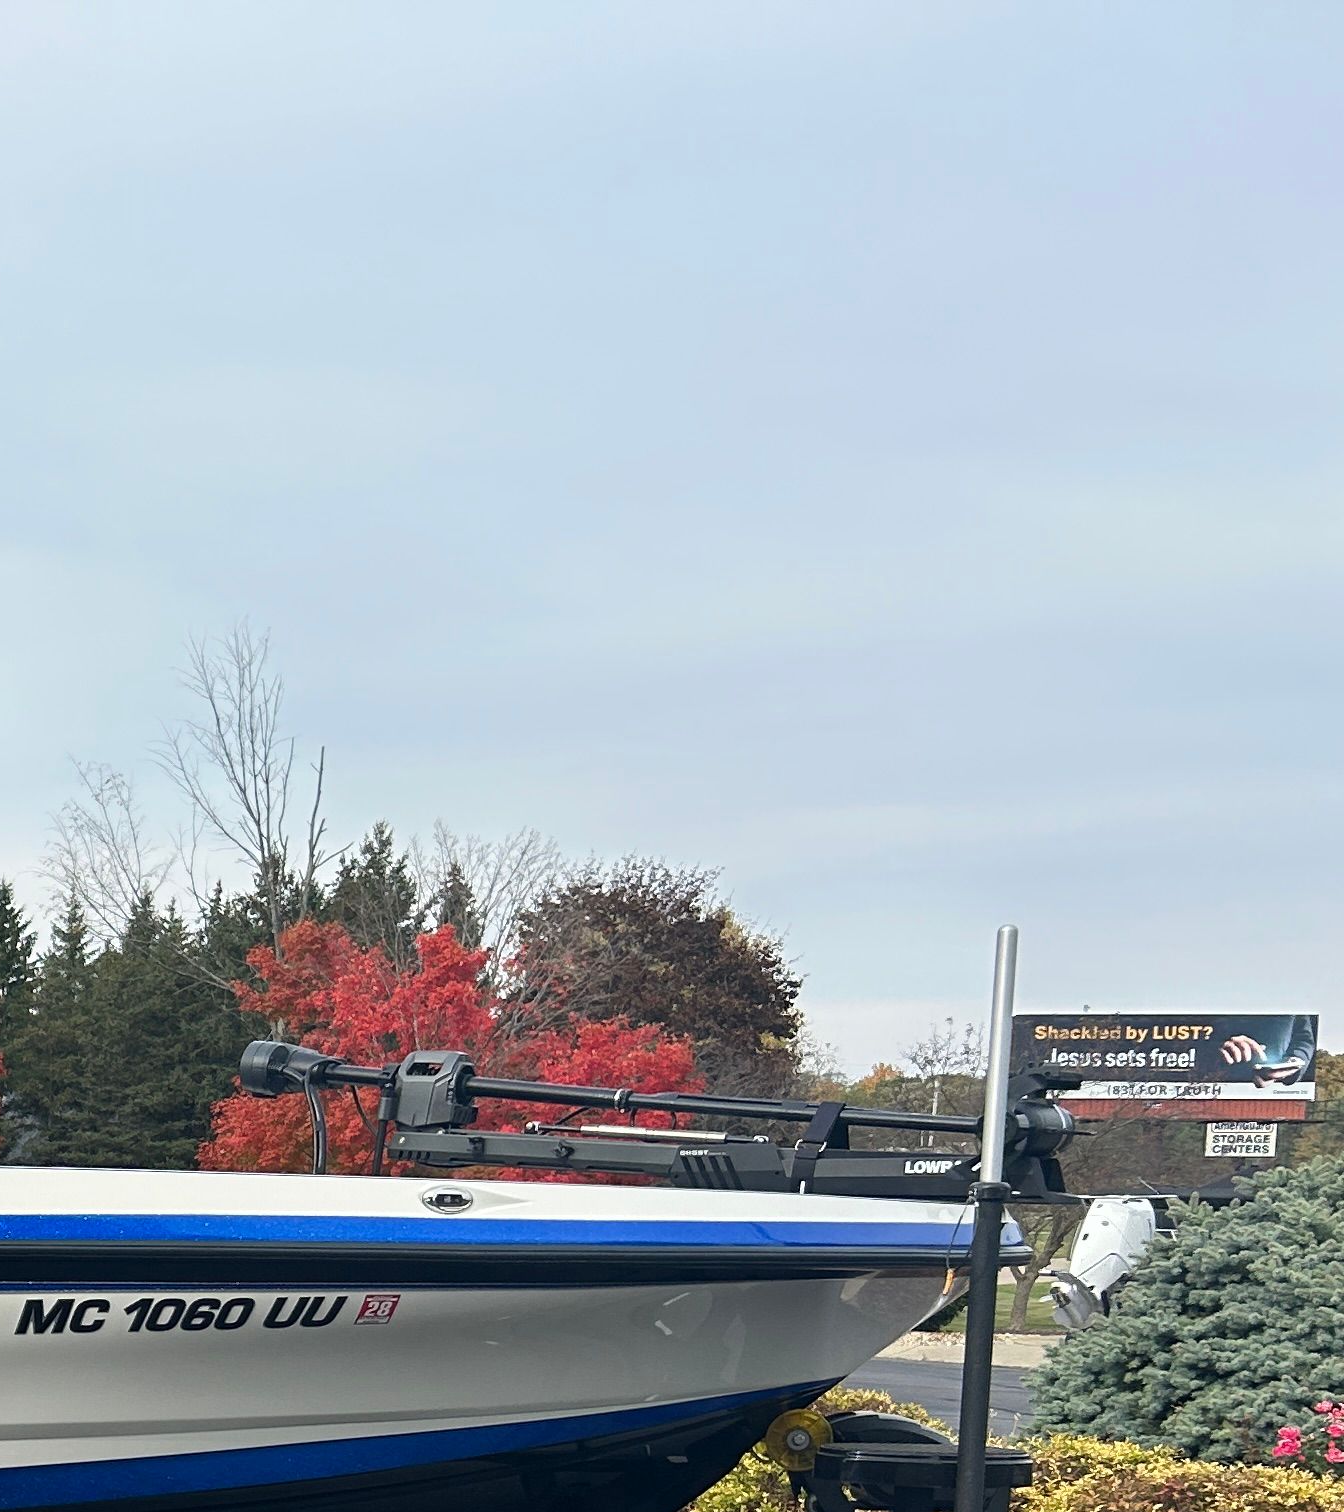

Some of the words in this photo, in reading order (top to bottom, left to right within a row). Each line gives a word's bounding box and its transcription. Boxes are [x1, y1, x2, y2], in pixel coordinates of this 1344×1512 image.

[1034, 1025, 1121, 1041] Shackled
[1126, 1025, 1149, 1043] by
[1152, 1025, 1214, 1040] LUST?
[1044, 1047, 1102, 1067] Jesus
[1104, 1049, 1146, 1068] sets
[1150, 1048, 1196, 1068] free!
[1212, 1135, 1271, 1144] STORAGE
[1212, 1145, 1270, 1154] CENTERS
[14, 1298, 111, 1336] MC
[123, 1297, 254, 1333] 1060
[262, 1295, 349, 1329] UU
[364, 1301, 393, 1317] 28
